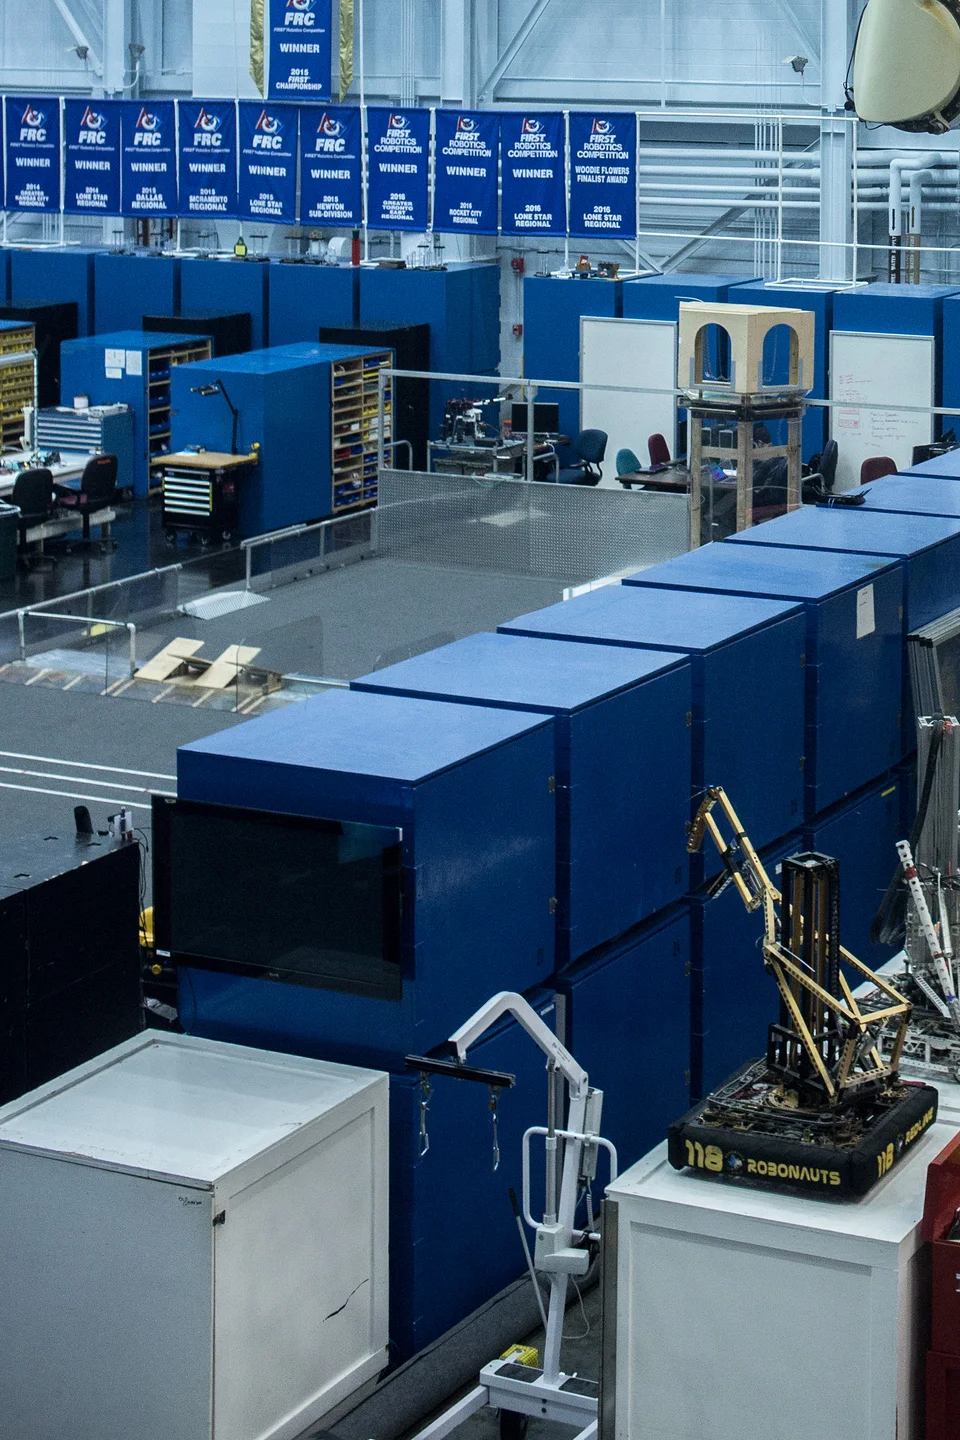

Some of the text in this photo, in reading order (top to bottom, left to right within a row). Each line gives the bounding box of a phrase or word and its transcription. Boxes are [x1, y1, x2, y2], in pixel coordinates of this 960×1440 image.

[284, 12, 315, 26] FRC
[280, 43, 320, 53] WINNER
[290, 68, 309, 76] 2015
[275, 82, 322, 90] CHAMPIONSHIP
[20, 128, 47, 141] FRC
[78, 131, 106, 144] FRC
[386, 129, 411, 138] FIRST
[455, 132, 480, 140] FIRST
[520, 134, 546, 142] FIRST
[134, 132, 162, 146] FRC
[193, 133, 222, 146] FRC
[252, 135, 283, 149] FRC
[380, 137, 417, 145] ROBOTICS
[589, 135, 616, 143] FIRST
[315, 138, 346, 152] FRC
[449, 140, 486, 149] ROBOTICS
[514, 142, 551, 150] ROBOTICS
[584, 143, 622, 151] ROBOTICS
[374, 145, 422, 154] COMPETITION
[442, 148, 492, 157] COMPETITION
[508, 150, 558, 158] COMPETITION
[577, 151, 629, 159] COMPETITION
[15, 157, 50, 167] WINNER
[75, 160, 110, 171] WINNER
[131, 163, 167, 172] WINNER
[189, 163, 226, 173] WINNER
[248, 165, 286, 177] WINNER
[379, 163, 418, 173] WINNER
[446, 166, 486, 177] WINNER
[575, 165, 630, 175] WOODIE FLOWERS
[310, 169, 351, 179] WINNER
[512, 169, 553, 178] WINNER
[577, 175, 628, 184] FINALIST AWARD
[189, 195, 228, 203] SACRAMENTO
[249, 199, 283, 208] LONE STAR
[77, 200, 107, 208] REGIONAL
[131, 201, 167, 209] REGIONAL
[189, 203, 227, 211] REGIONAL
[250, 207, 282, 215] REGIONAL
[309, 210, 352, 218] SUB-DIVISION
[685, 1139, 723, 1172] 118
[877, 1142, 894, 1177] 118
[747, 1159, 841, 1185] ROBONAUTS
